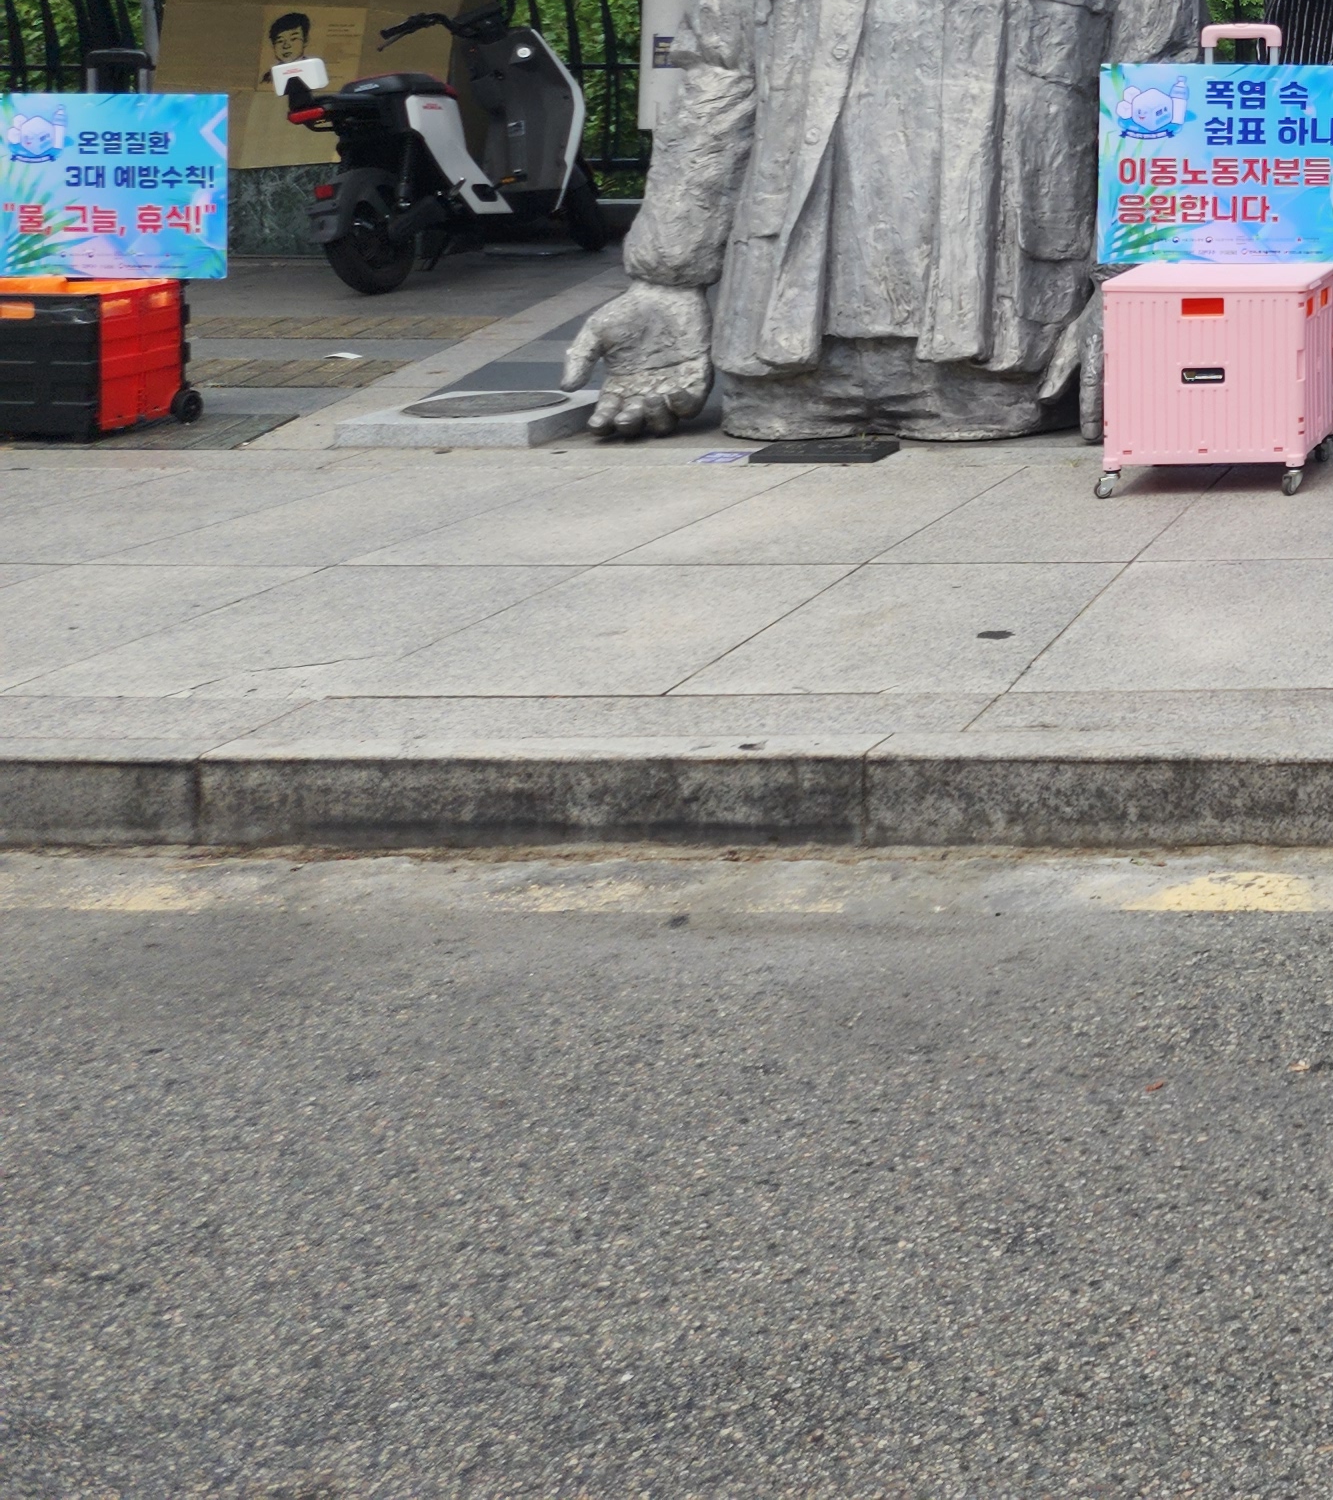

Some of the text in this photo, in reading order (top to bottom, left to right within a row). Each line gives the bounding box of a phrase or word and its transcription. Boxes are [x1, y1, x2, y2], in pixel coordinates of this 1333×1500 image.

[1205, 80, 1309, 110] 폭염 속
[77, 131, 171, 155] 온열질환
[1204, 116, 1266, 146] 쉼표
[65, 166, 215, 189] 3대 예방수칙!
[63, 204, 126, 236] 그늘,
[1117, 194, 1279, 223] 응원합니다.
